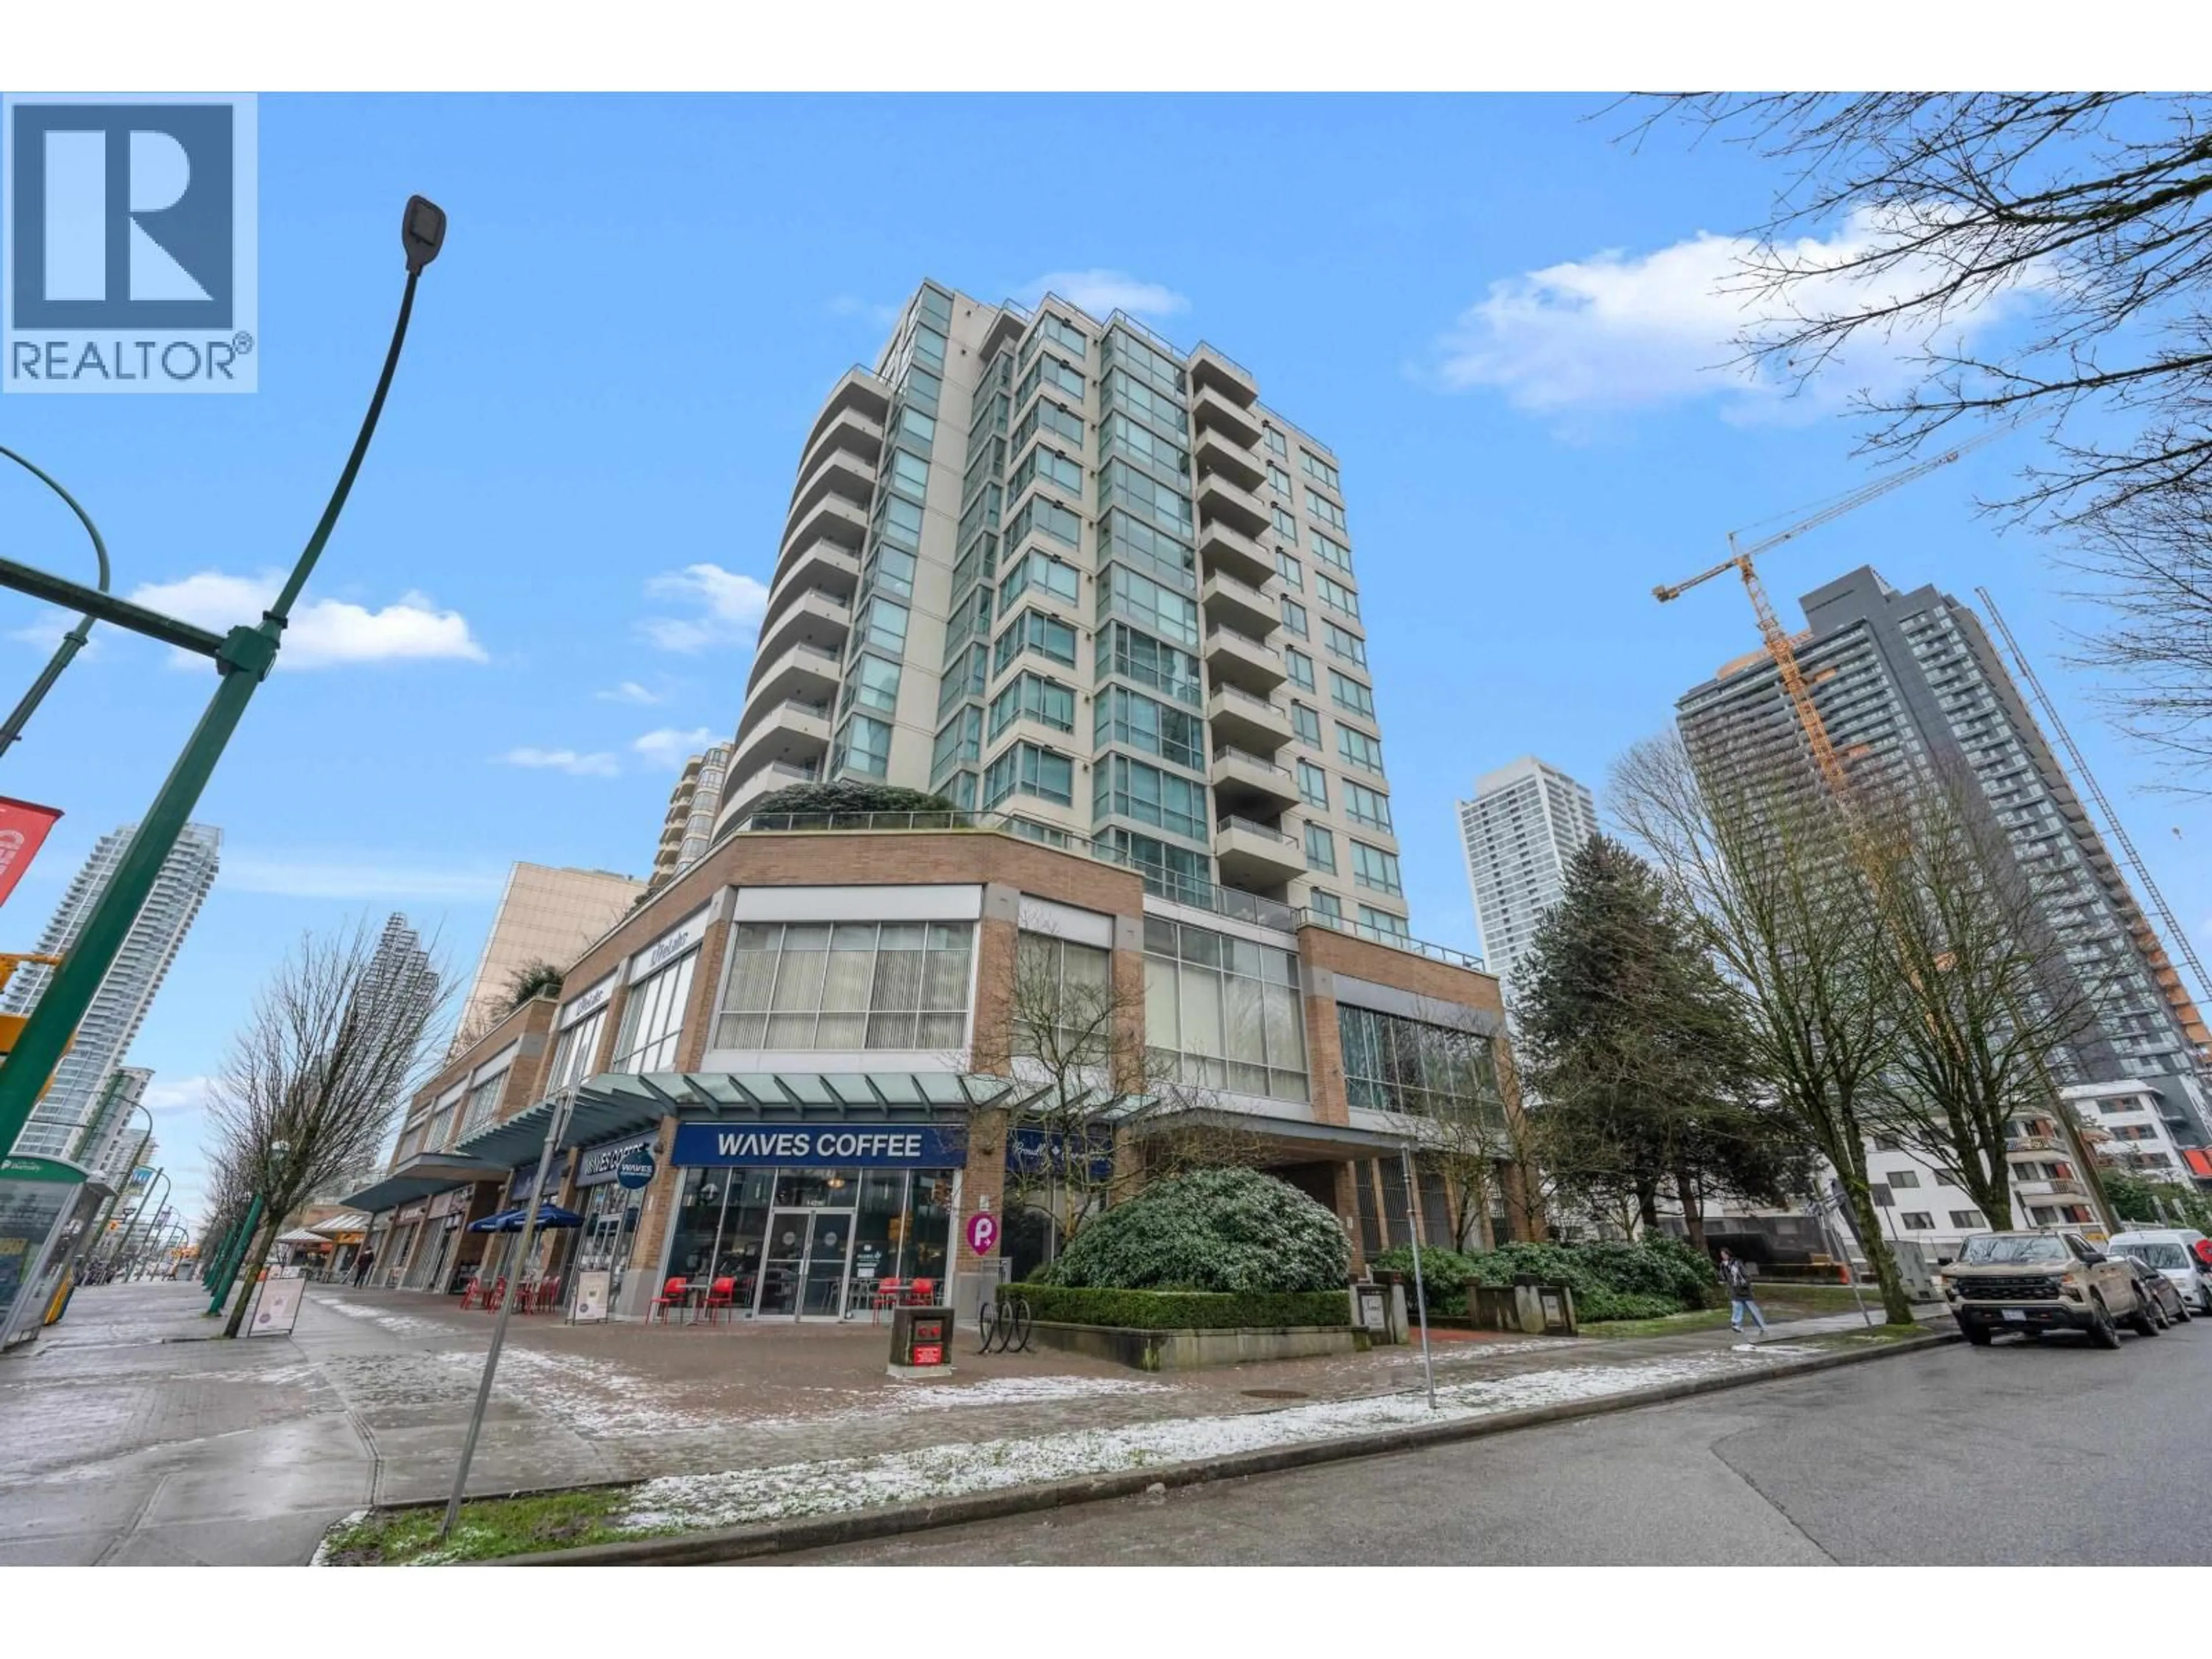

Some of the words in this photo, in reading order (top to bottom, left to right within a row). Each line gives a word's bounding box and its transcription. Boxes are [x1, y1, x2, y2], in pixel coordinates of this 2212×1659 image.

[718, 1133, 810, 1156] WAVES
[816, 1133, 922, 1157] COFFEE
[622, 1164, 653, 1172] WAVES
